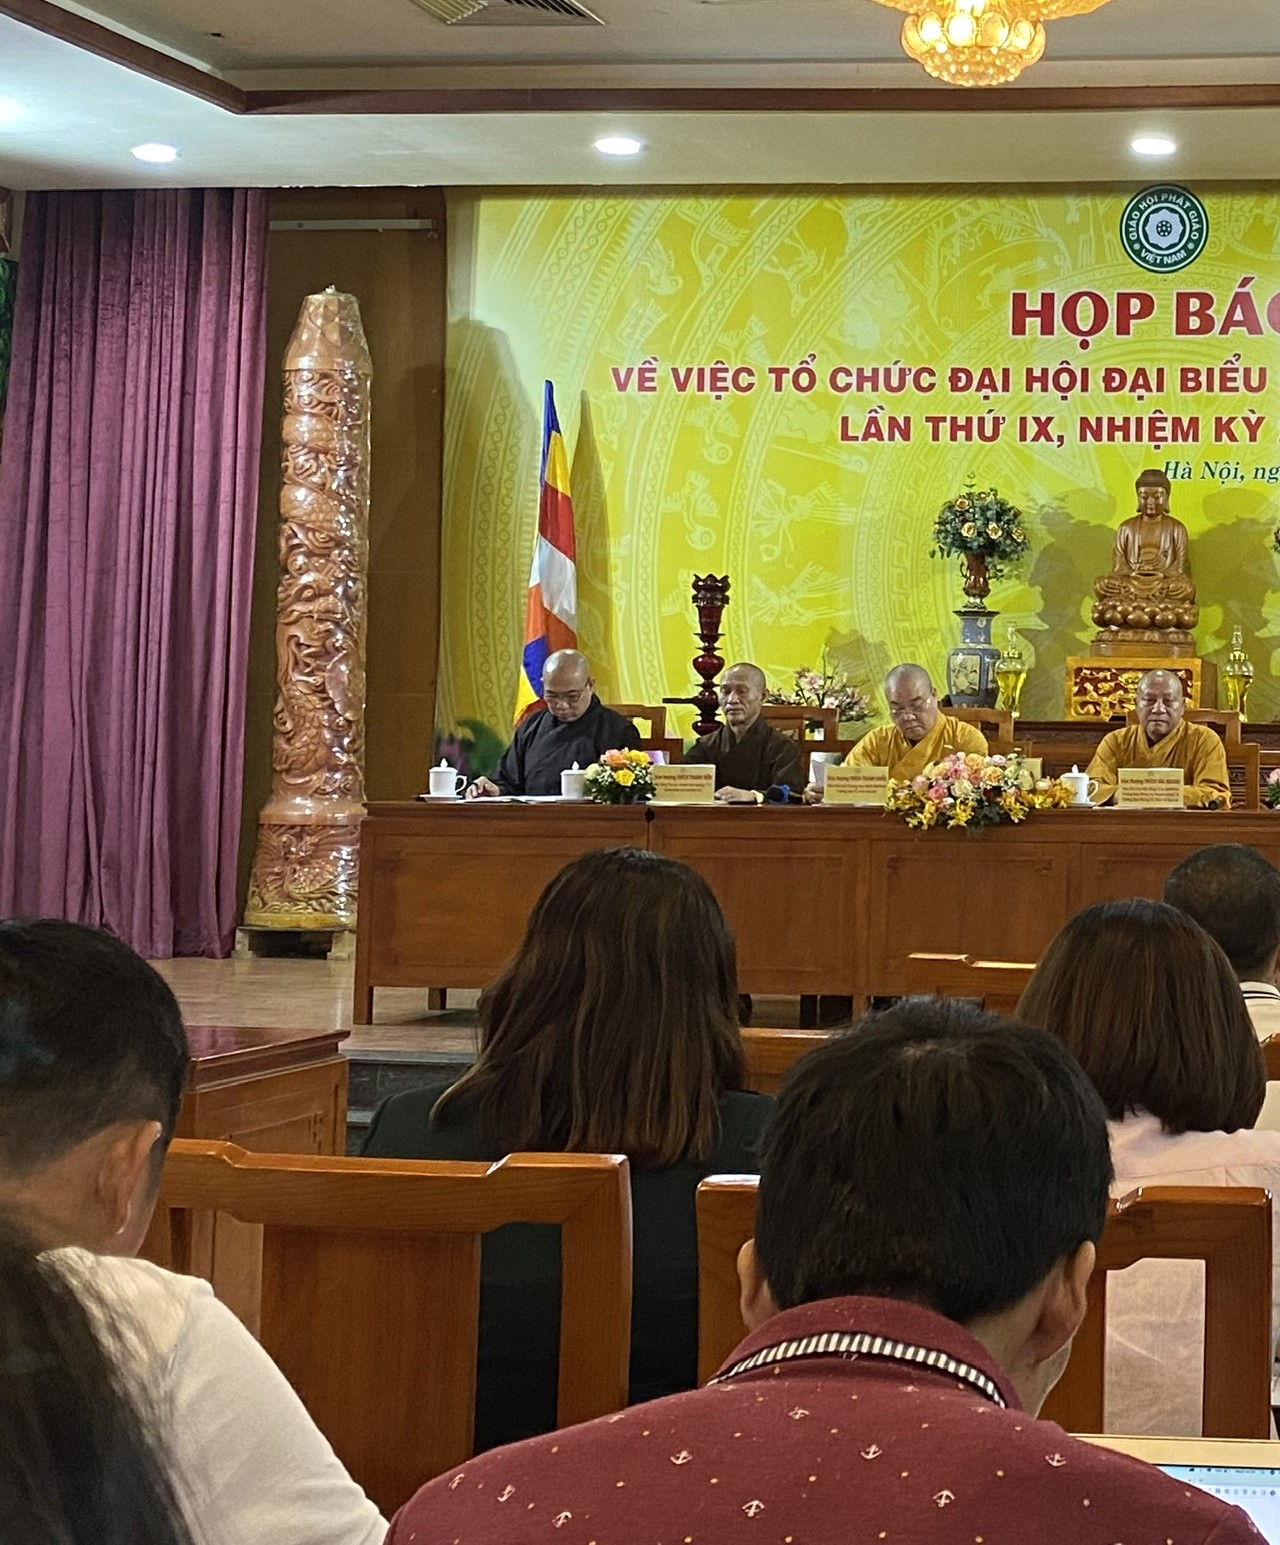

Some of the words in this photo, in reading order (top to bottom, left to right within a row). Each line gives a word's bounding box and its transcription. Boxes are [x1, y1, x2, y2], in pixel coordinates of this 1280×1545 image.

[1128, 211, 1140, 240] GIÁO
[1188, 210, 1201, 240] GIÁO
[1140, 248, 1162, 264] VIỆT
[1163, 249, 1187, 264] NAM
[1011, 291, 1156, 351] HỌP
[611, 356, 660, 393] VỀ
[671, 361, 756, 401] VIỆC
[768, 353, 818, 394] TỔ
[829, 360, 938, 394] CHỨC
[948, 367, 1011, 402] ĐẠI
[1025, 360, 1090, 402] HỘI
[1103, 367, 1166, 402] ĐẠI
[1179, 353, 1268, 394] BIỂU
[840, 405, 912, 443] LẦN
[924, 409, 1007, 444] THỨ
[1019, 416, 1066, 449] IX,
[1079, 410, 1201, 451] NHIỆM
[1214, 409, 1267, 444] KỲ
[1164, 461, 1193, 480] Hà
[1200, 461, 1246, 484] Nội,
